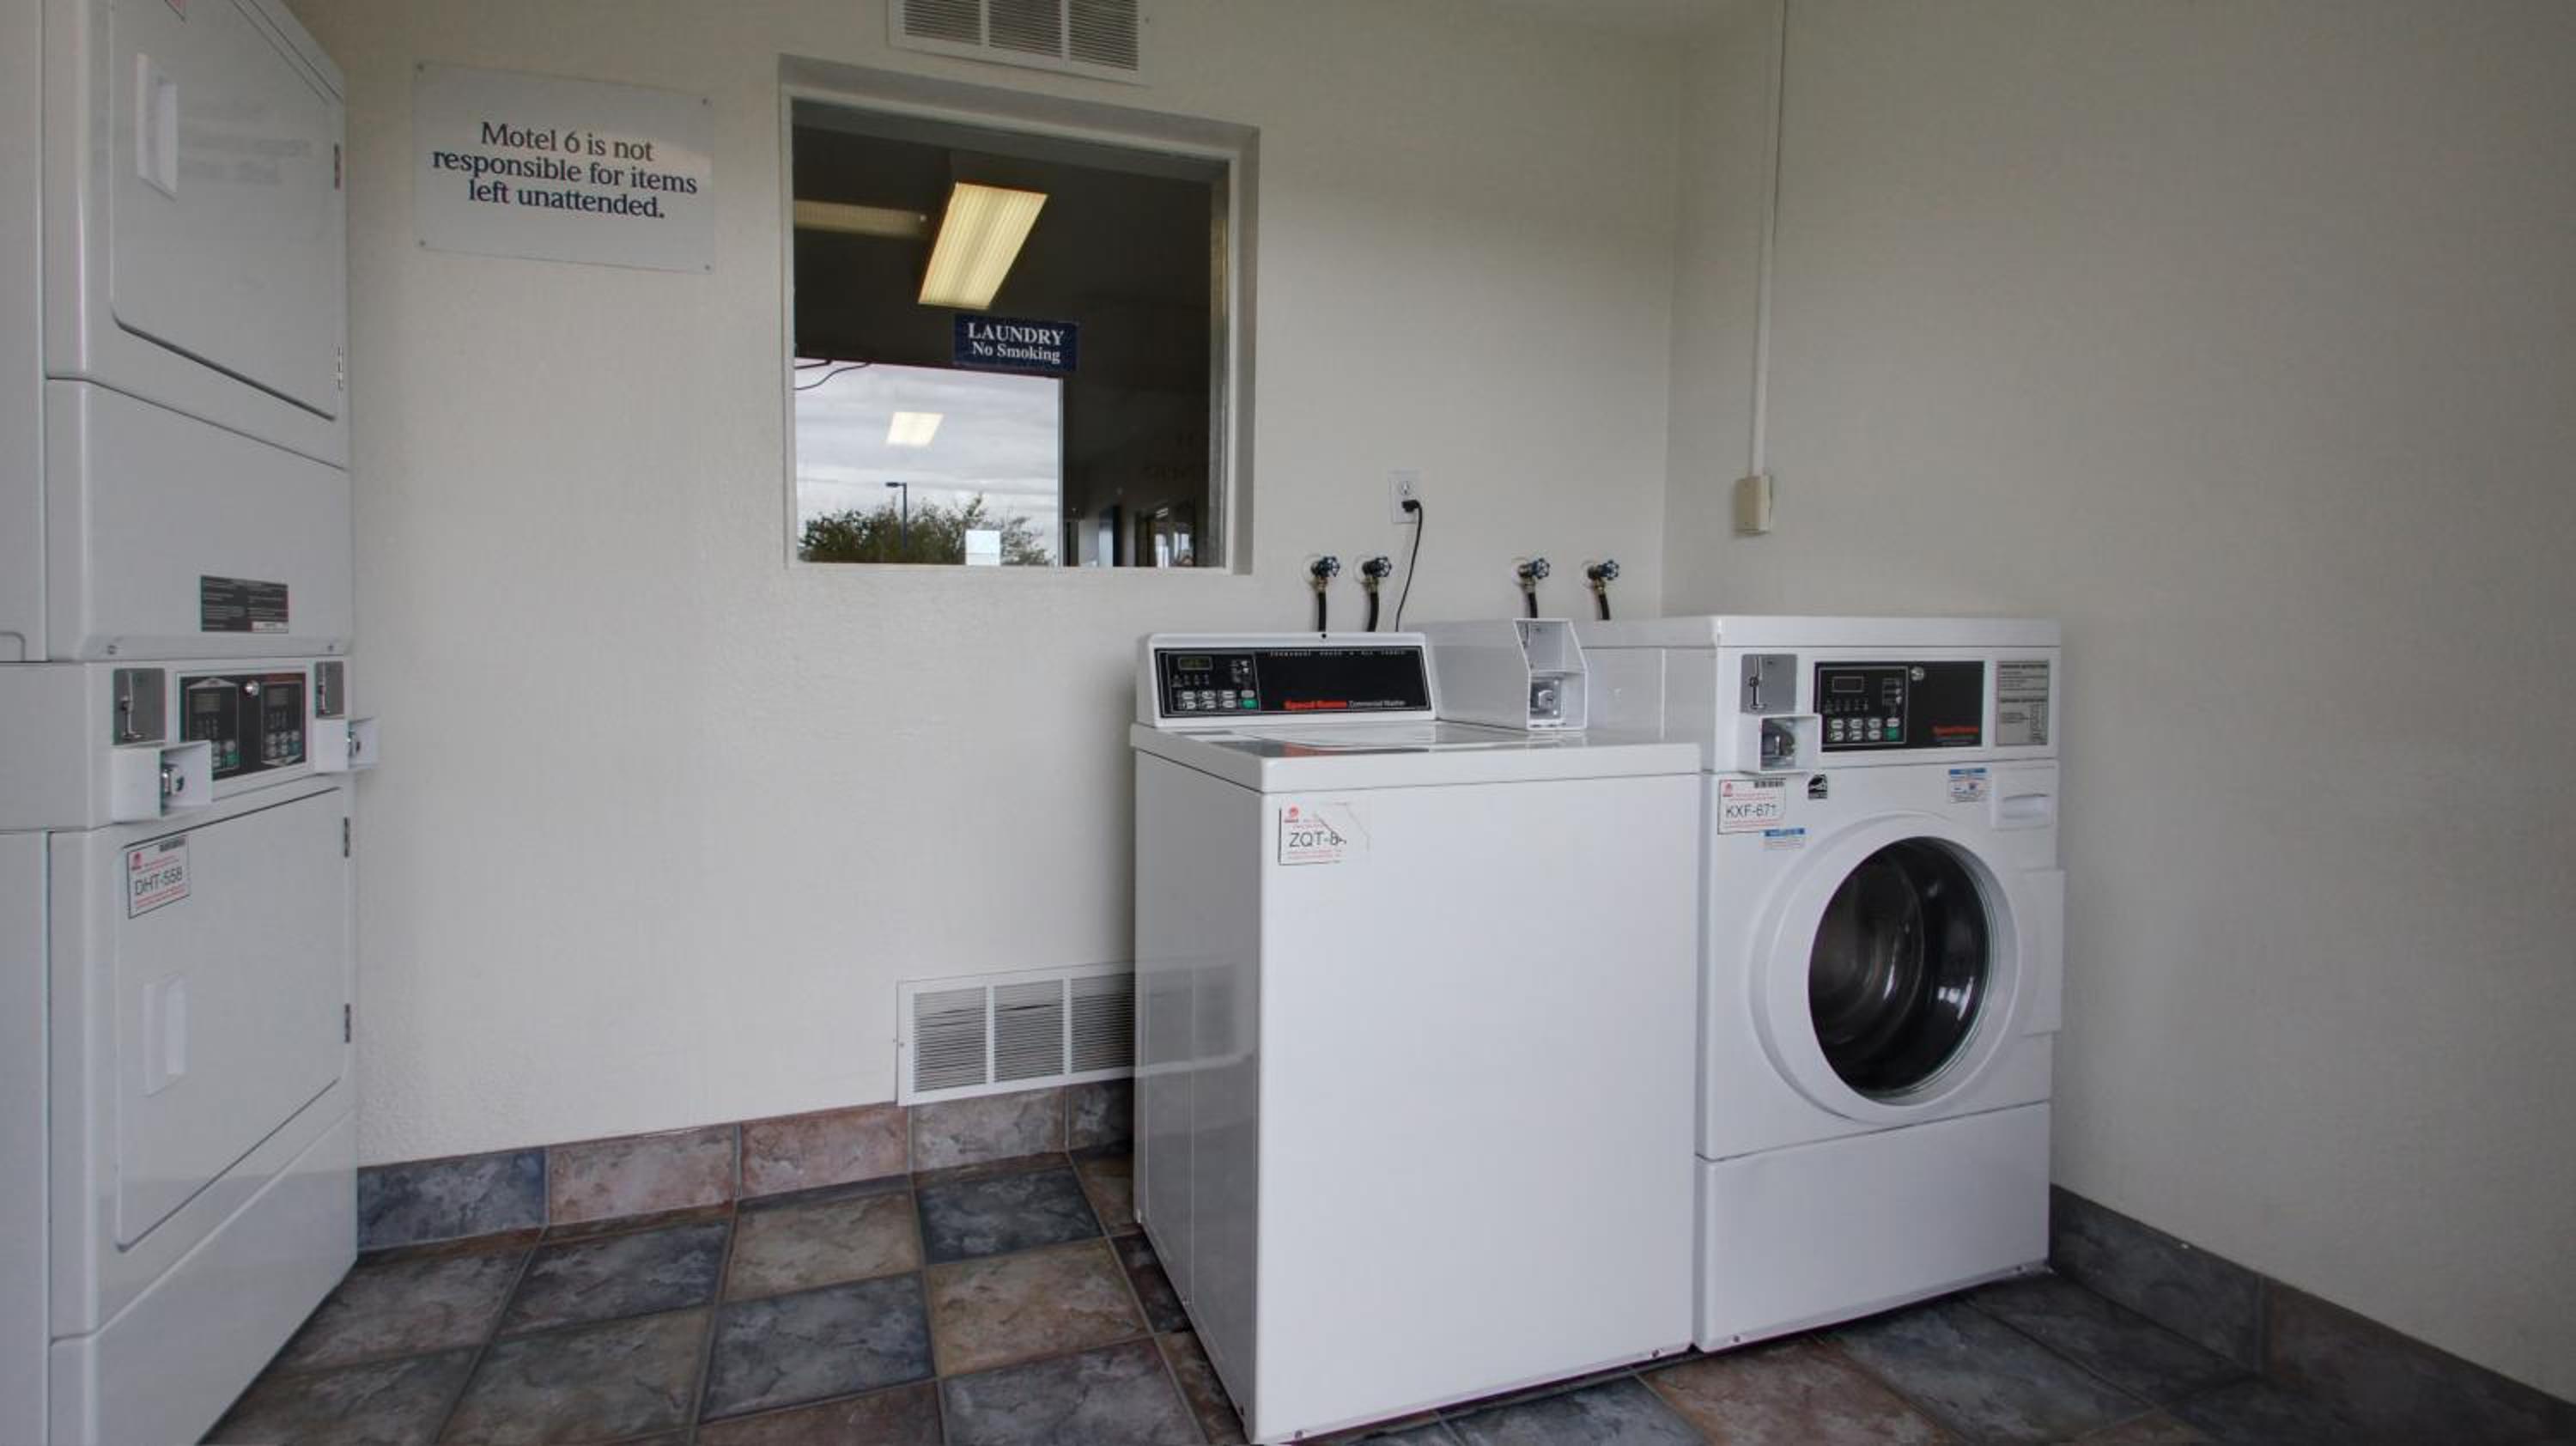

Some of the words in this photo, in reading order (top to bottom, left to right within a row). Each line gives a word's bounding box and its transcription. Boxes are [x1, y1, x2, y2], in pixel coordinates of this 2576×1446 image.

[481, 122, 556, 150] Motel
[564, 131, 580, 153] 6
[587, 133, 605, 155] is
[614, 141, 653, 161] not
[433, 150, 581, 182] responsible
[590, 162, 623, 186] for
[630, 167, 697, 194] items
[469, 179, 510, 203] left
[518, 187, 665, 219] unattended.
[968, 322, 1064, 345] LAUNDRY
[972, 341, 993, 356] No
[997, 343, 1060, 364] Smoking
